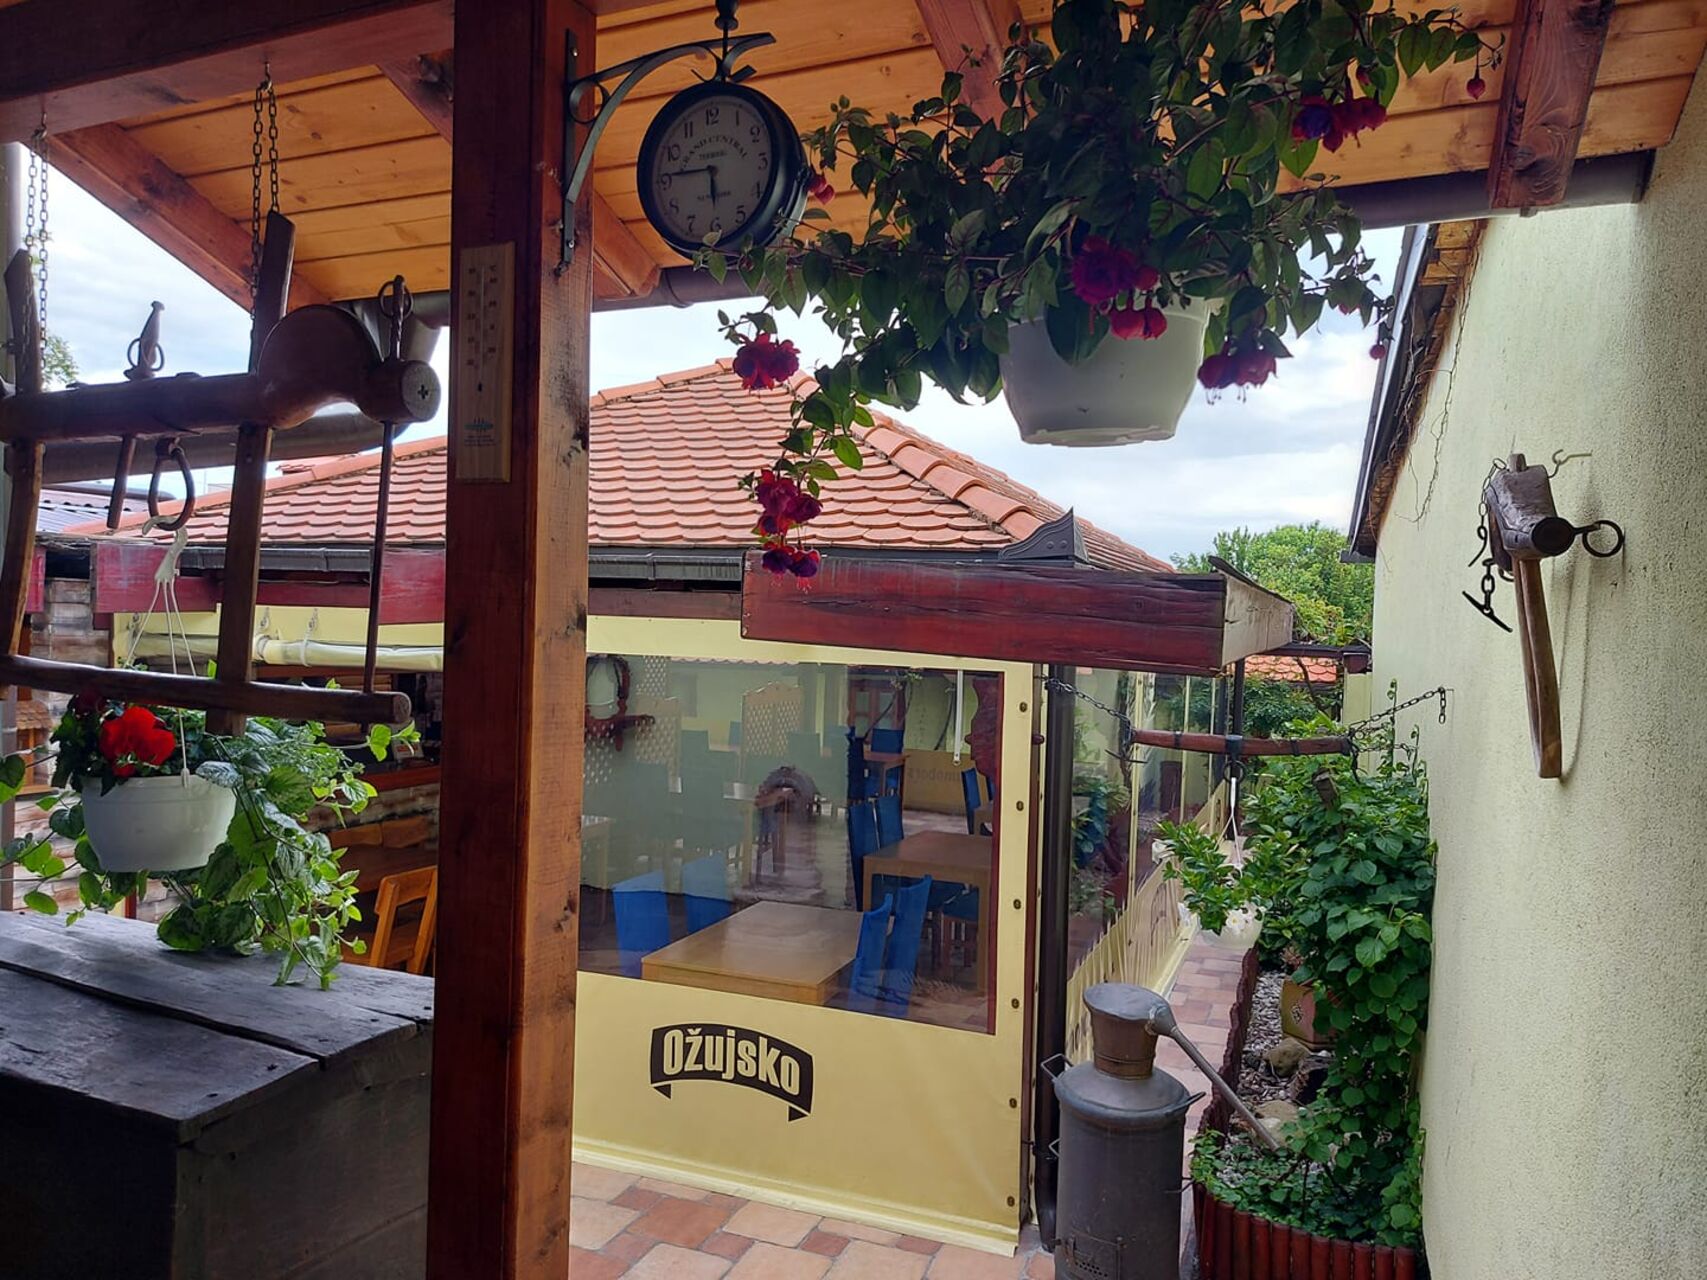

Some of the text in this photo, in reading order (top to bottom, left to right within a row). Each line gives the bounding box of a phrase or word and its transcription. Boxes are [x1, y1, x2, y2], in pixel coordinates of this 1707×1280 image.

[705, 107, 720, 126] 12
[684, 121, 694, 139] 11
[750, 124, 761, 143] 2
[667, 143, 681, 162] 10
[758, 152, 769, 171] 3
[660, 173, 673, 191] 9
[751, 181, 764, 199] 4
[669, 198, 680, 214] 8
[735, 205, 746, 225] 5
[687, 214, 697, 232] 7
[710, 217, 722, 232] 6
[662, 1027, 800, 1096] Ožujsko
